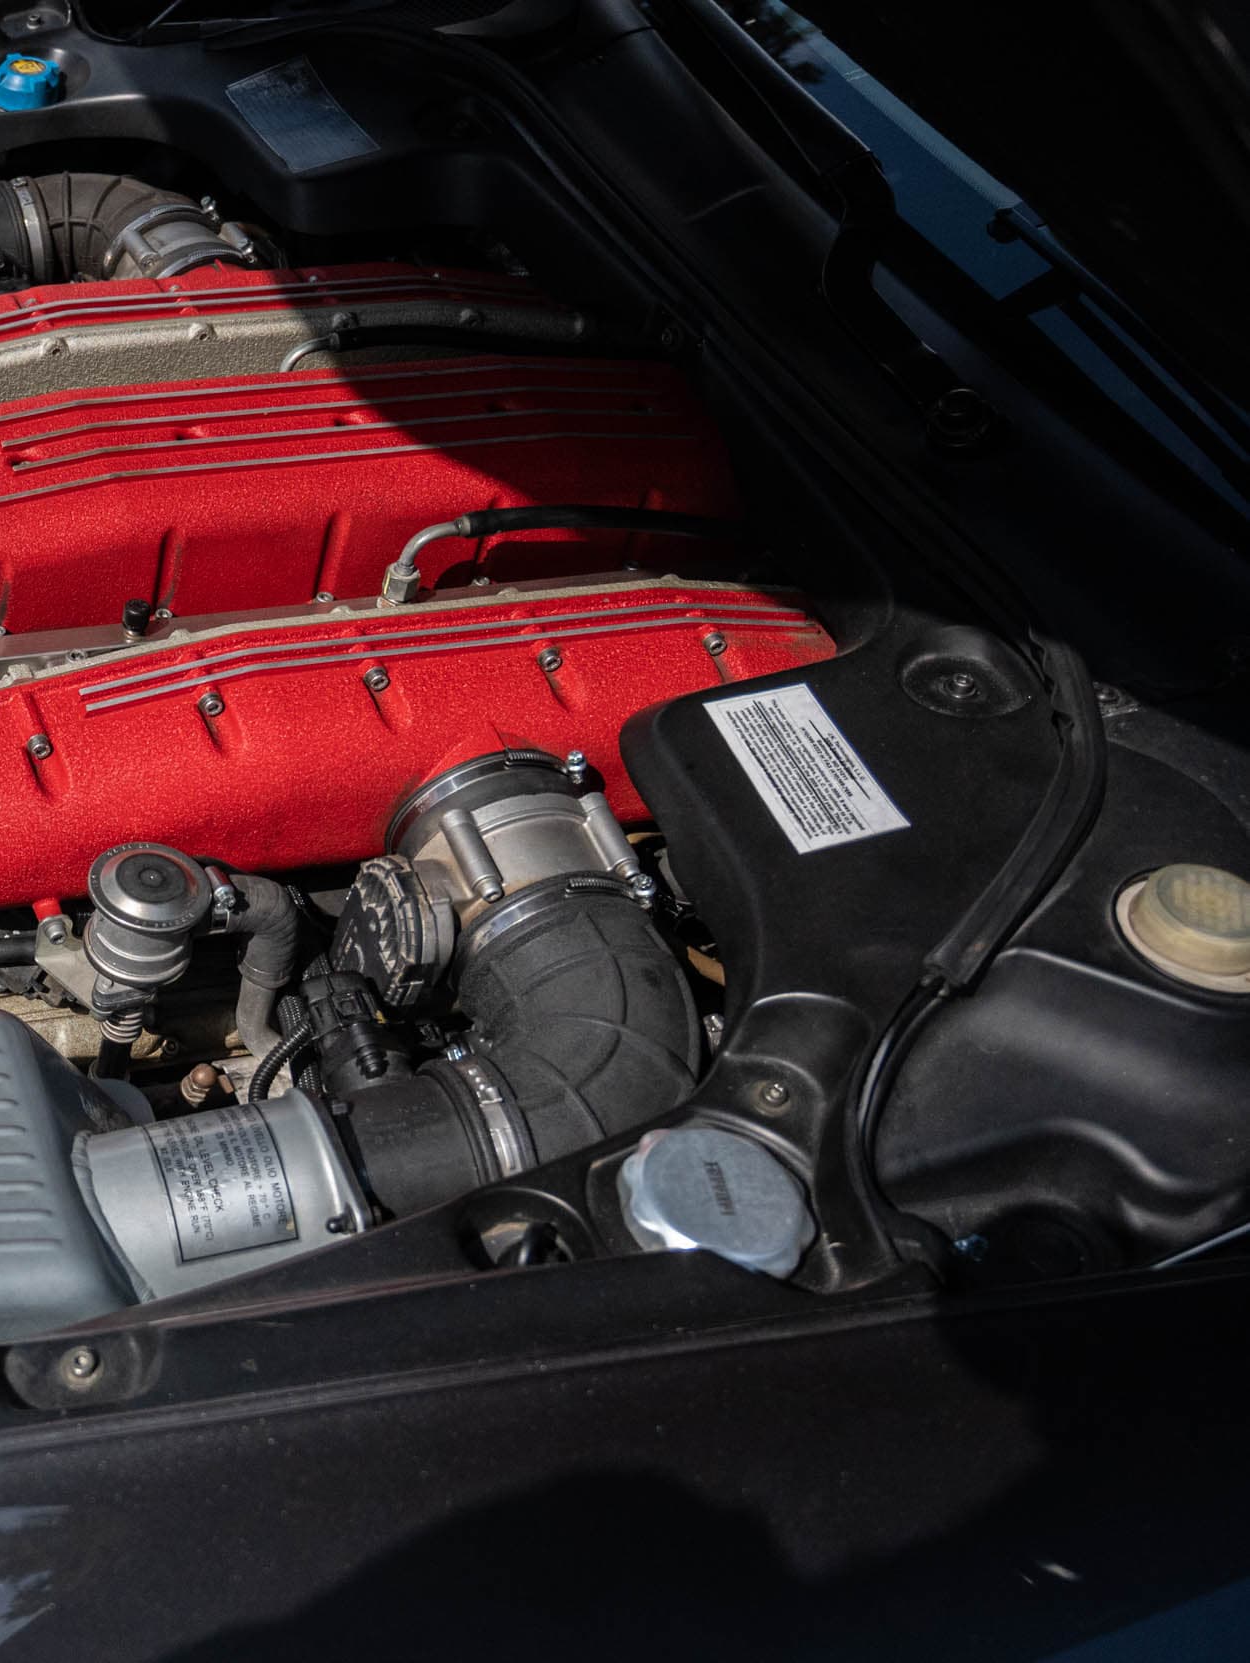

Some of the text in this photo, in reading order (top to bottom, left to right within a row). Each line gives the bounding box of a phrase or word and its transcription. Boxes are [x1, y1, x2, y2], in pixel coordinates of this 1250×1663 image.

[198, 1149, 214, 1174] LEVEL
[208, 1178, 226, 1212] CHECK
[244, 1181, 251, 1191] AL
[247, 1194, 262, 1227] REGIME
[271, 1182, 288, 1224] MOTORE
